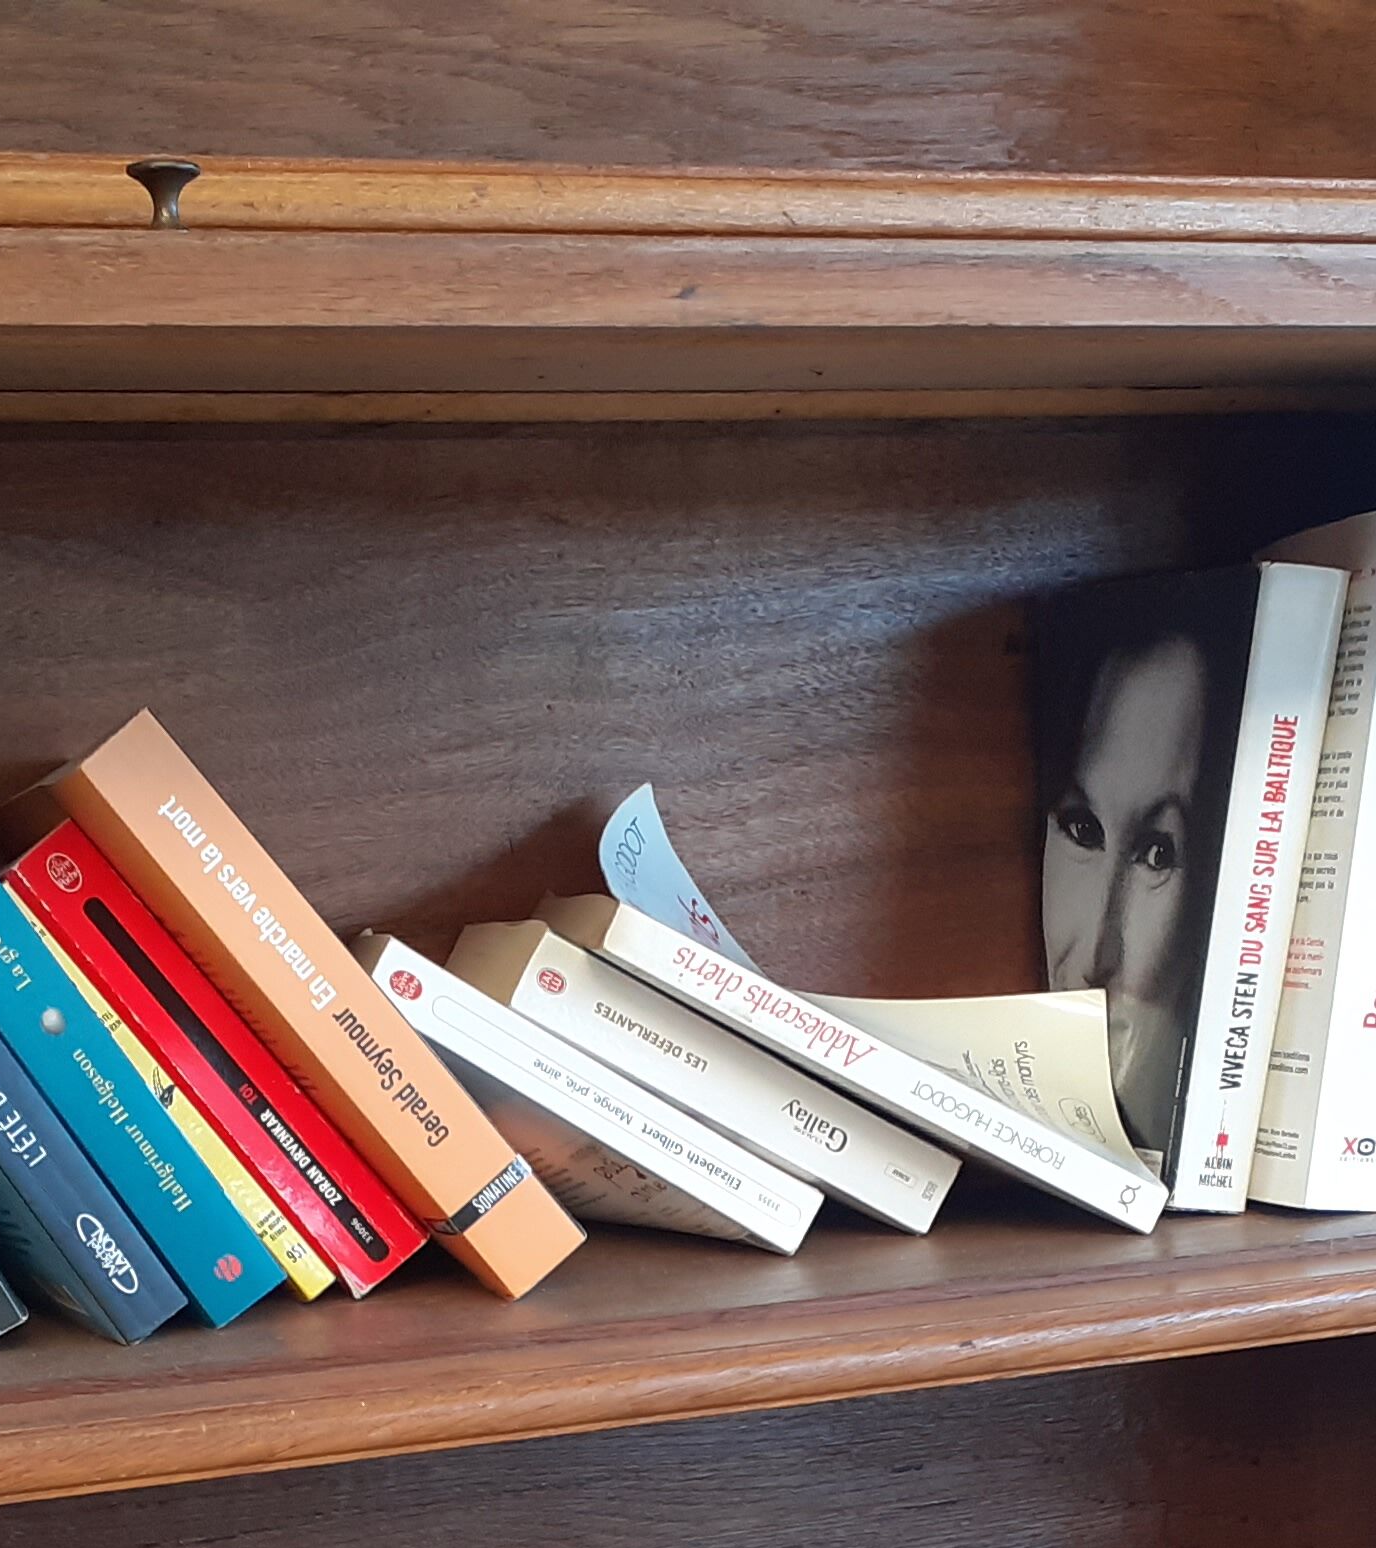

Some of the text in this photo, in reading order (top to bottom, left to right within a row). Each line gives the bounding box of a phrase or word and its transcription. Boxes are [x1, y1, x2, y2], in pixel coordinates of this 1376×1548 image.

[1218, 713, 1298, 1090] VIVECA STEN DU SANG SUR LA BALTIQUE
[10, 963, 32, 991] La
[156, 795, 449, 1147] Gerald Seymour En marche vers la mort
[671, 946, 876, 1067] Adolescents chéris
[593, 1000, 708, 1073] LES DÉFERLANTES
[72, 1048, 129, 1125] Helgason
[532, 1057, 562, 1080] aime
[564, 1074, 591, 1097] prie,
[237, 1082, 258, 1104] TOI
[592, 1090, 633, 1126] Mange,
[909, 1079, 993, 1131] HUGODOT
[259, 1108, 311, 1169] DRVENKAR
[640, 1122, 684, 1156] Gilbert
[782, 1098, 848, 1153] Gallay
[991, 1120, 1066, 1170] FLORENCE
[124, 1124, 192, 1212] Hallgrímur
[685, 1149, 742, 1191] Elizabeth
[1198, 1173, 1233, 1188] MICHEL
[1204, 1156, 1232, 1170] ALBIN
[305, 1164, 343, 1206] ZORAN
[467, 1163, 524, 1216] SONATINE
[349, 1216, 374, 1244] 33096
[86, 1233, 116, 1270] Michel
